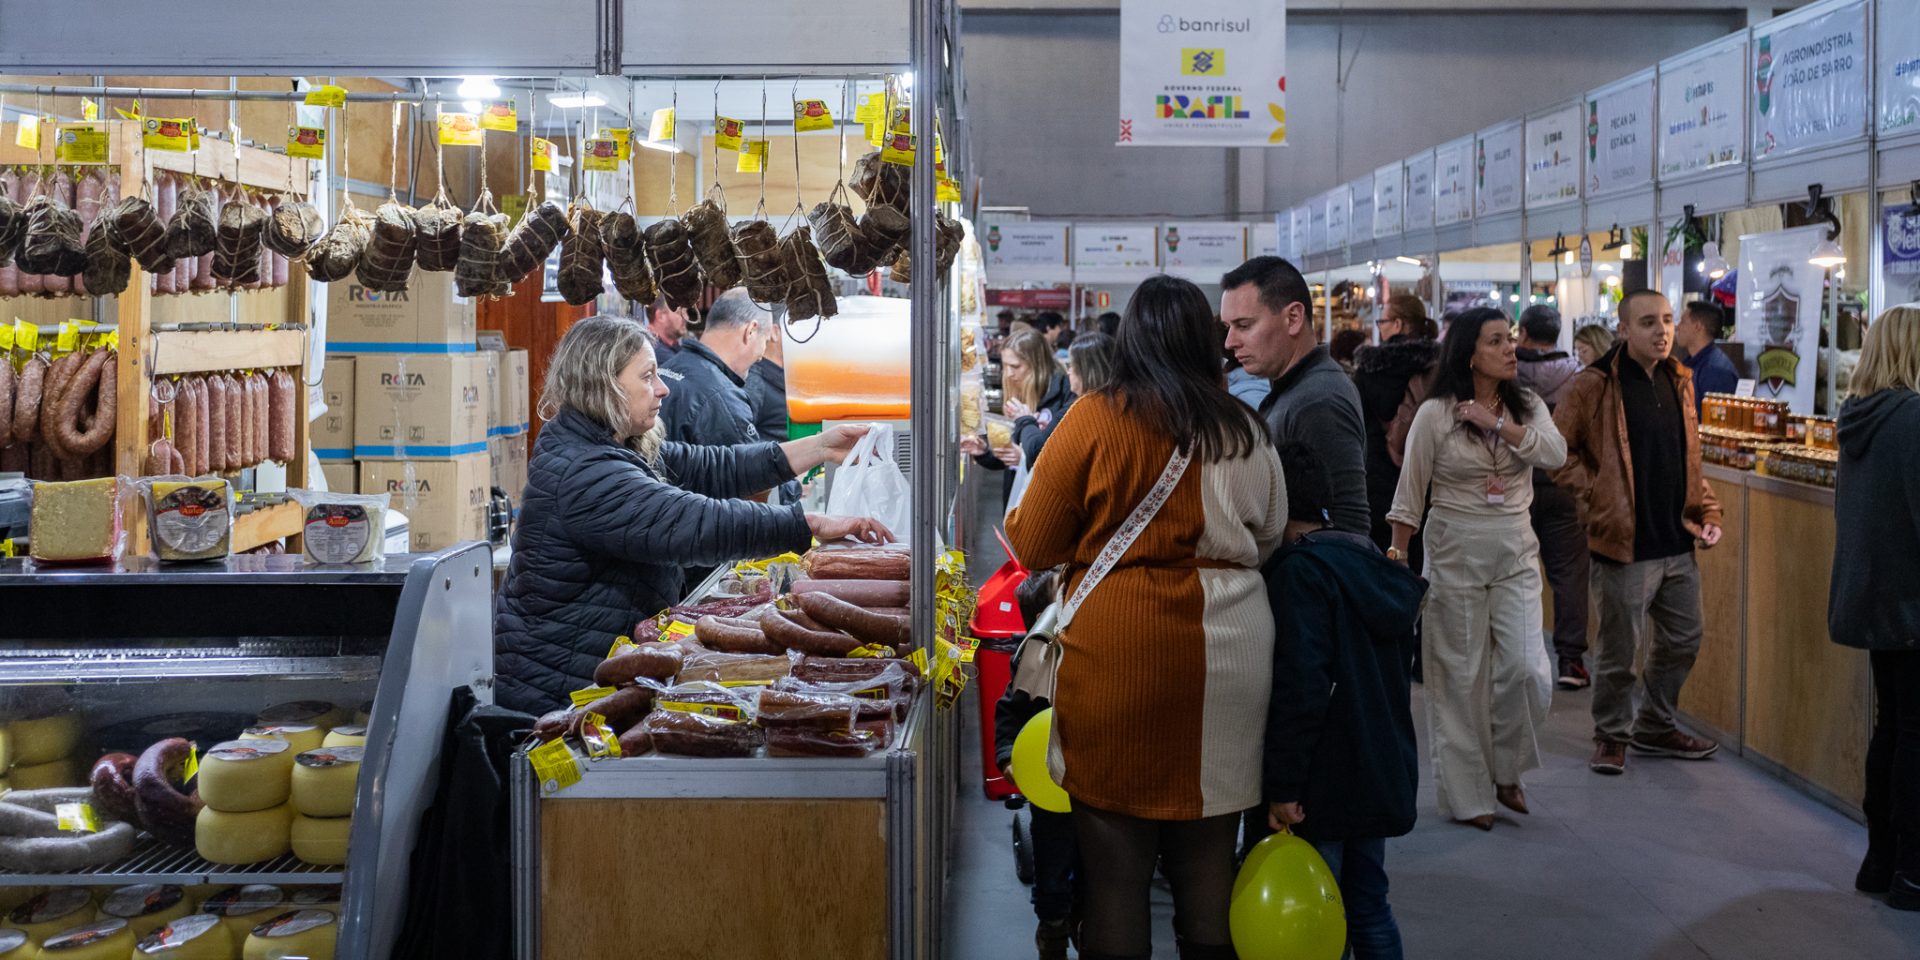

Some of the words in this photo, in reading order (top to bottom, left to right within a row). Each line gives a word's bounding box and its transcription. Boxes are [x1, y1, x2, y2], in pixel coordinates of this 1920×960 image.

[1179, 18, 1250, 33] banrisul
[1782, 31, 1854, 66] AGROINDÚSTRIA
[1782, 67, 1806, 89] JOÃO
[1807, 64, 1820, 81] DE
[1821, 55, 1854, 78] BARRO
[1206, 85, 1243, 93] FEDERAL
[1155, 95, 1250, 119] BRASIL
[349, 284, 409, 302] ROTA
[381, 373, 426, 386] ROTA
